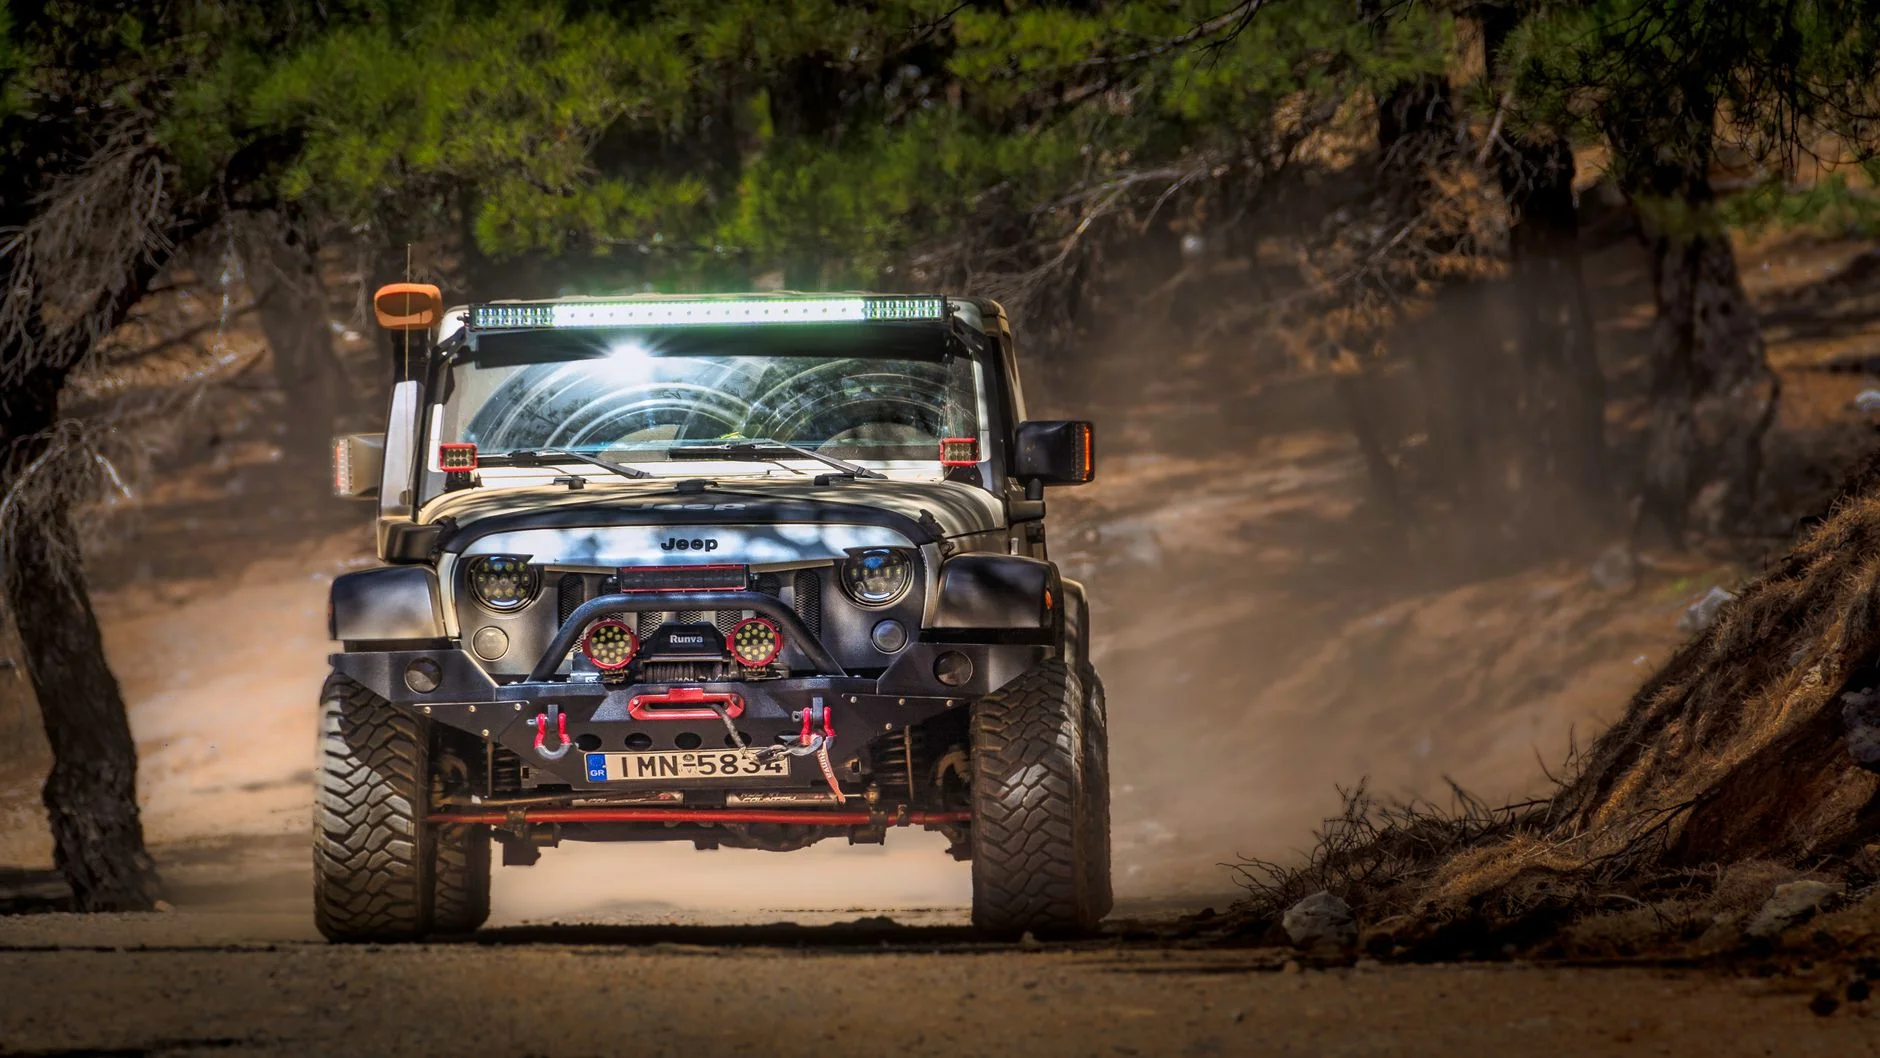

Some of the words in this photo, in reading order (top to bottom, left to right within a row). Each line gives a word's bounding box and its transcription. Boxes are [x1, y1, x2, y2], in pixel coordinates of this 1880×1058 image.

[660, 537, 718, 552] Jeep
[669, 634, 704, 643] Runva
[590, 769, 605, 777] GR
